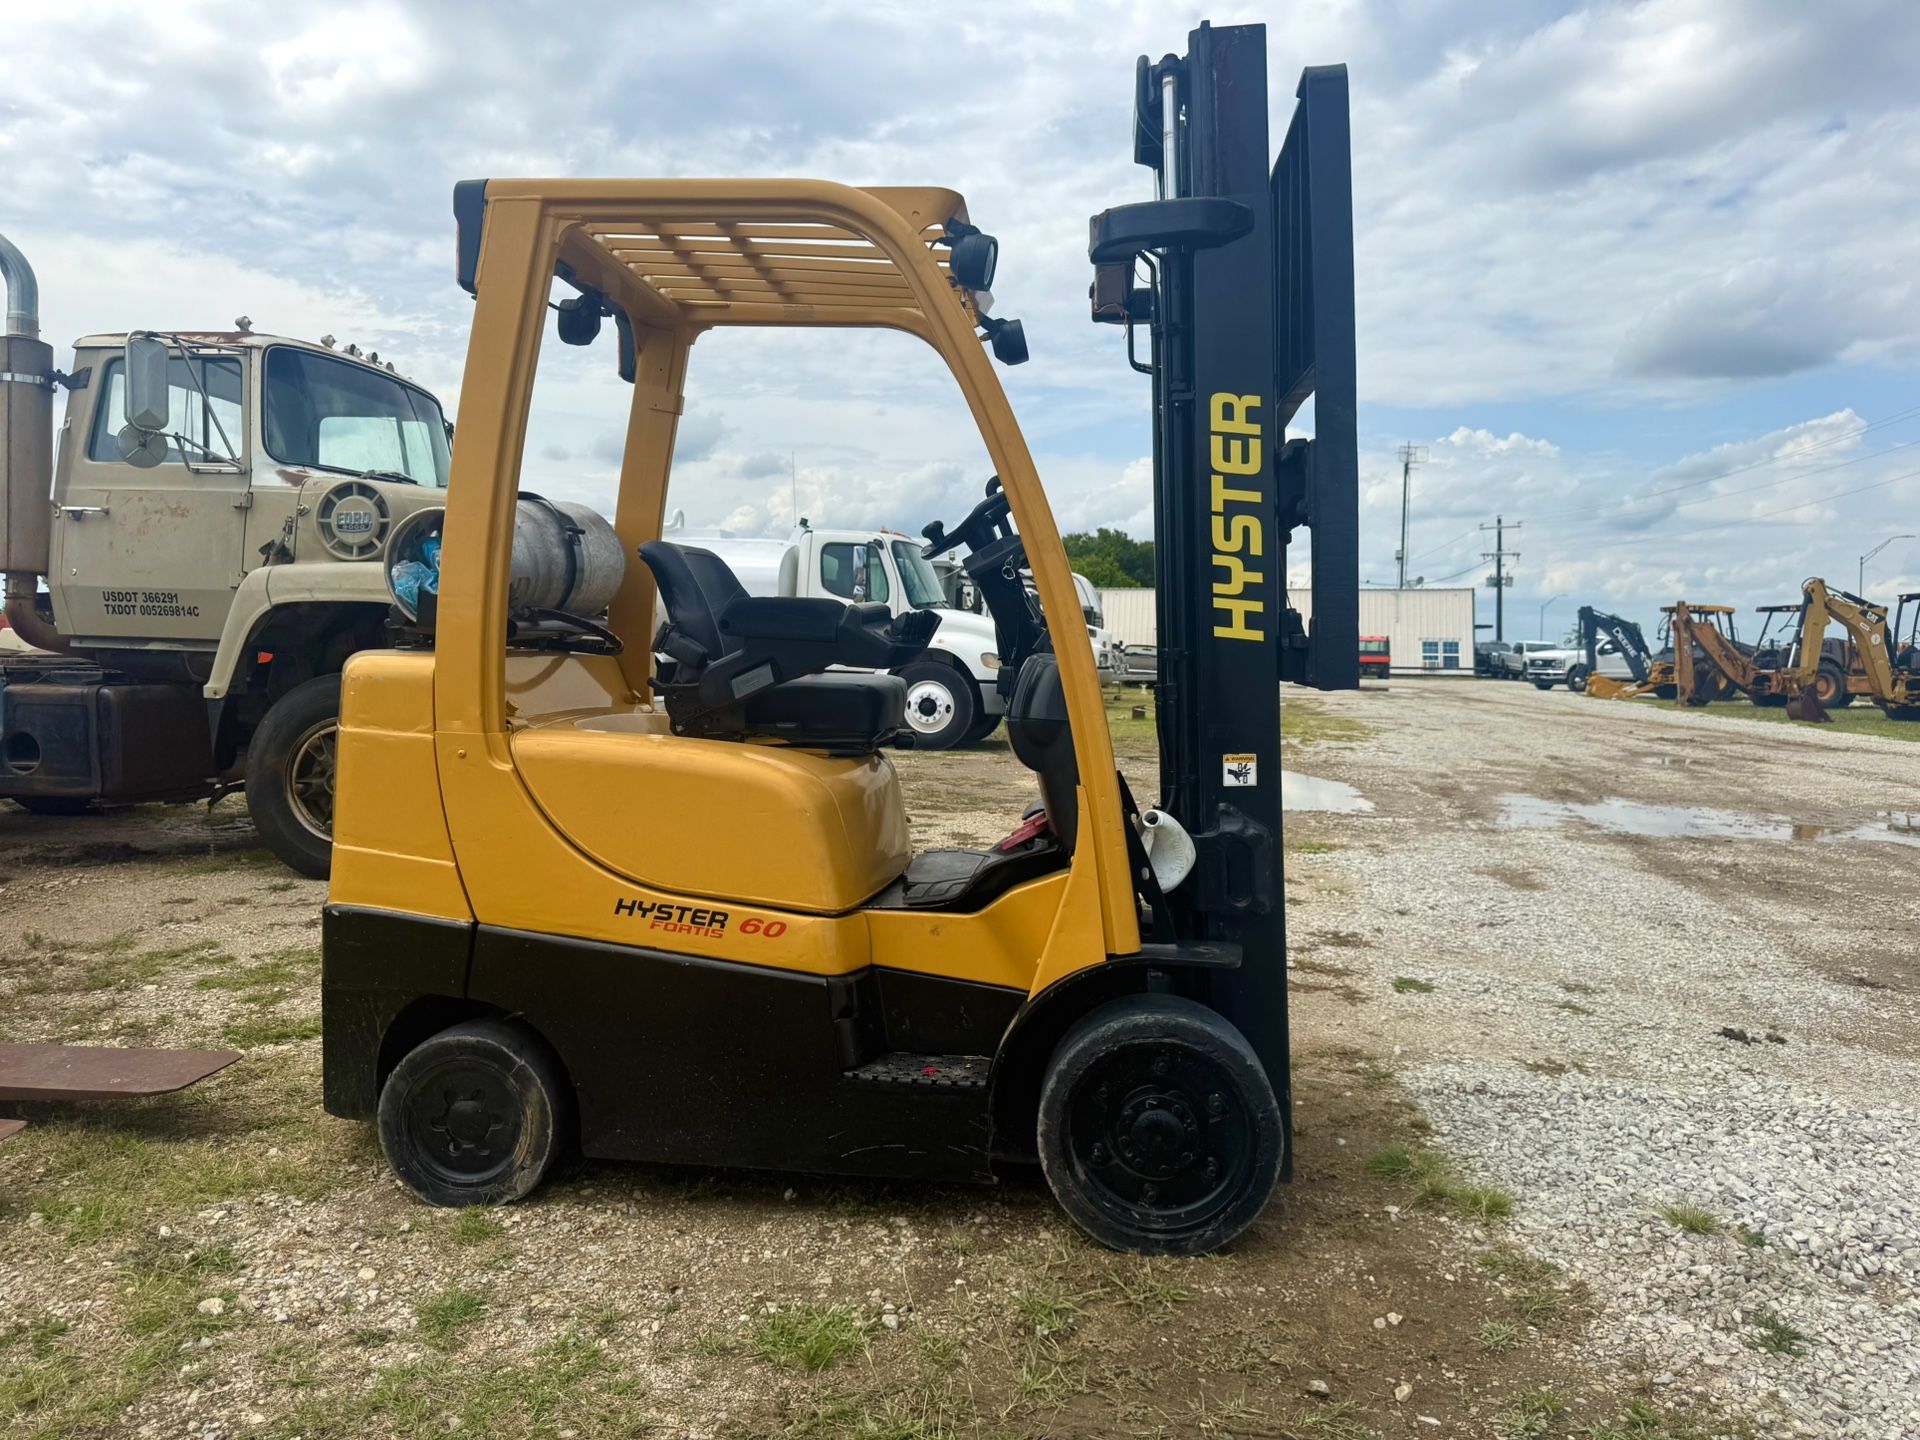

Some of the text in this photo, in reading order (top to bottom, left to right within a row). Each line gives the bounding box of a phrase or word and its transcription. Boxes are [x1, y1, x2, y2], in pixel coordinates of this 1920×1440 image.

[337, 512, 371, 525] FORD
[1211, 392, 1264, 642] HYSTER
[102, 591, 179, 603] USDOT 366291
[104, 604, 200, 617] TXDOT 005269814C
[1866, 611, 1879, 624] CAT
[1612, 626, 1638, 658] DEERE
[614, 898, 788, 938] HYSTER 60
[650, 920, 725, 939] FORTIS
